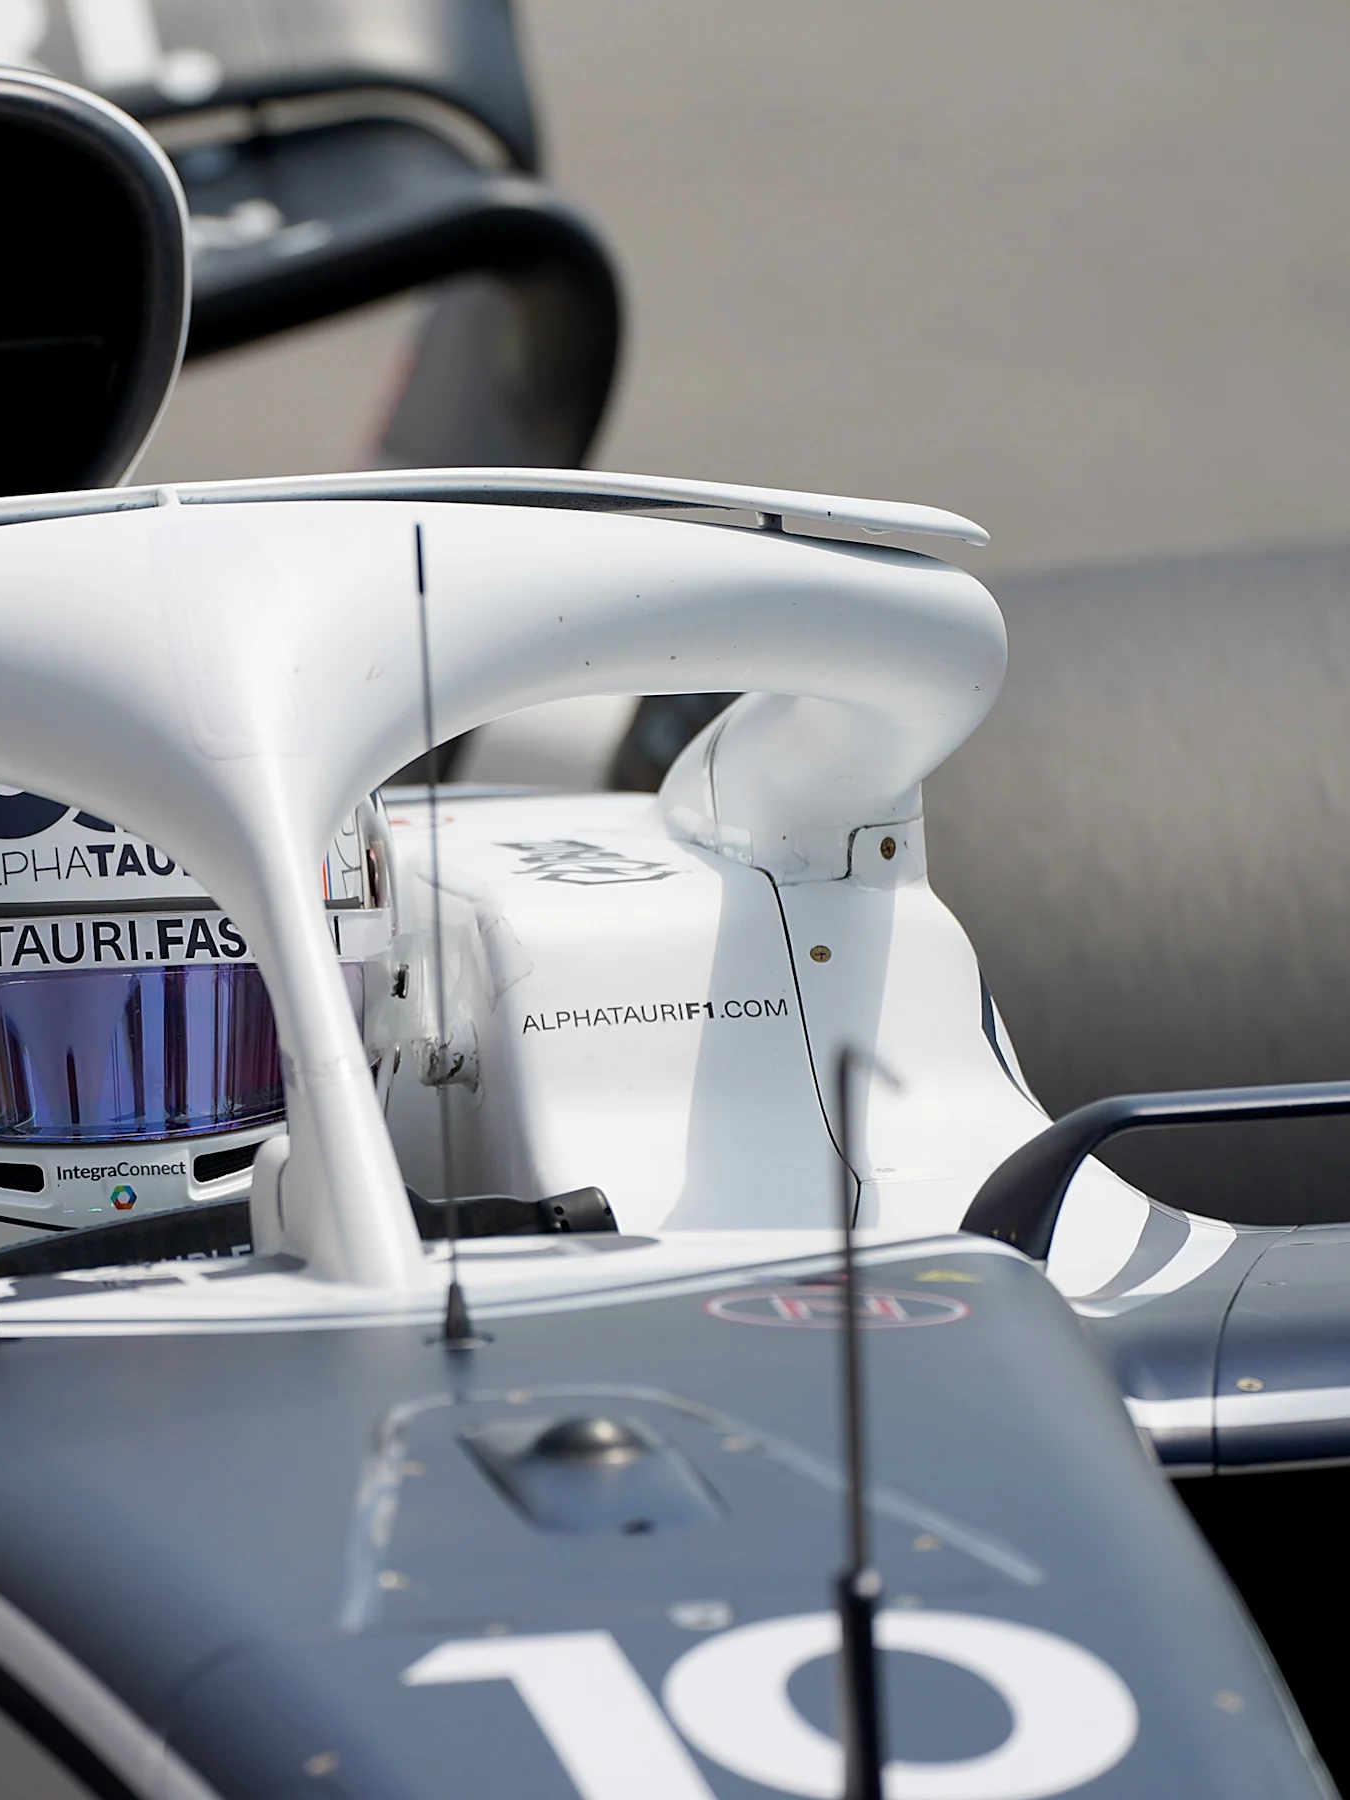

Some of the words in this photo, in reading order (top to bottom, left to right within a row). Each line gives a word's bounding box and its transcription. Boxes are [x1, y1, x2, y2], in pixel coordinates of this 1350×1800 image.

[522, 998, 788, 1034] ALPHATAURIF1.COM
[56, 1161, 187, 1181] IntegraConnect
[400, 1609, 1139, 1800] 10
